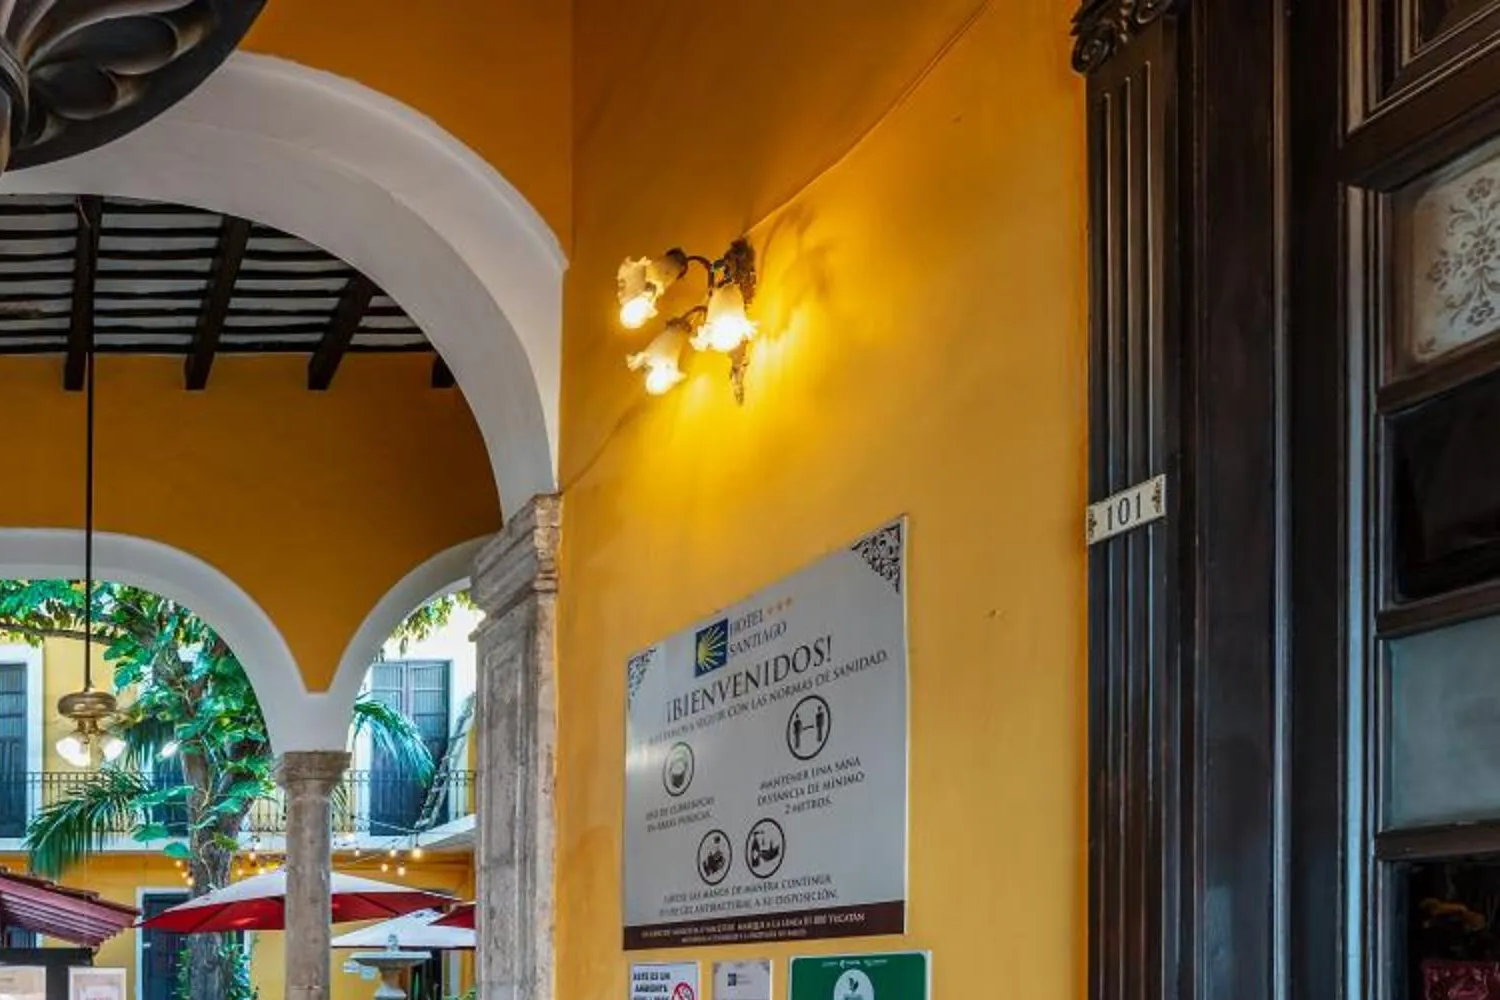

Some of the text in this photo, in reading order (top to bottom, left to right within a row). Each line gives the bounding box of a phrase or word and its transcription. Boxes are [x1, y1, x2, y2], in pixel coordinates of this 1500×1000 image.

[1107, 491, 1141, 531] 101
[729, 619, 788, 656] SANTIAGO
[730, 608, 762, 636] HOTEL
[727, 702, 748, 717] CON
[751, 695, 766, 709] LAS
[769, 678, 812, 702] NORMAS
[815, 672, 830, 686] DE
